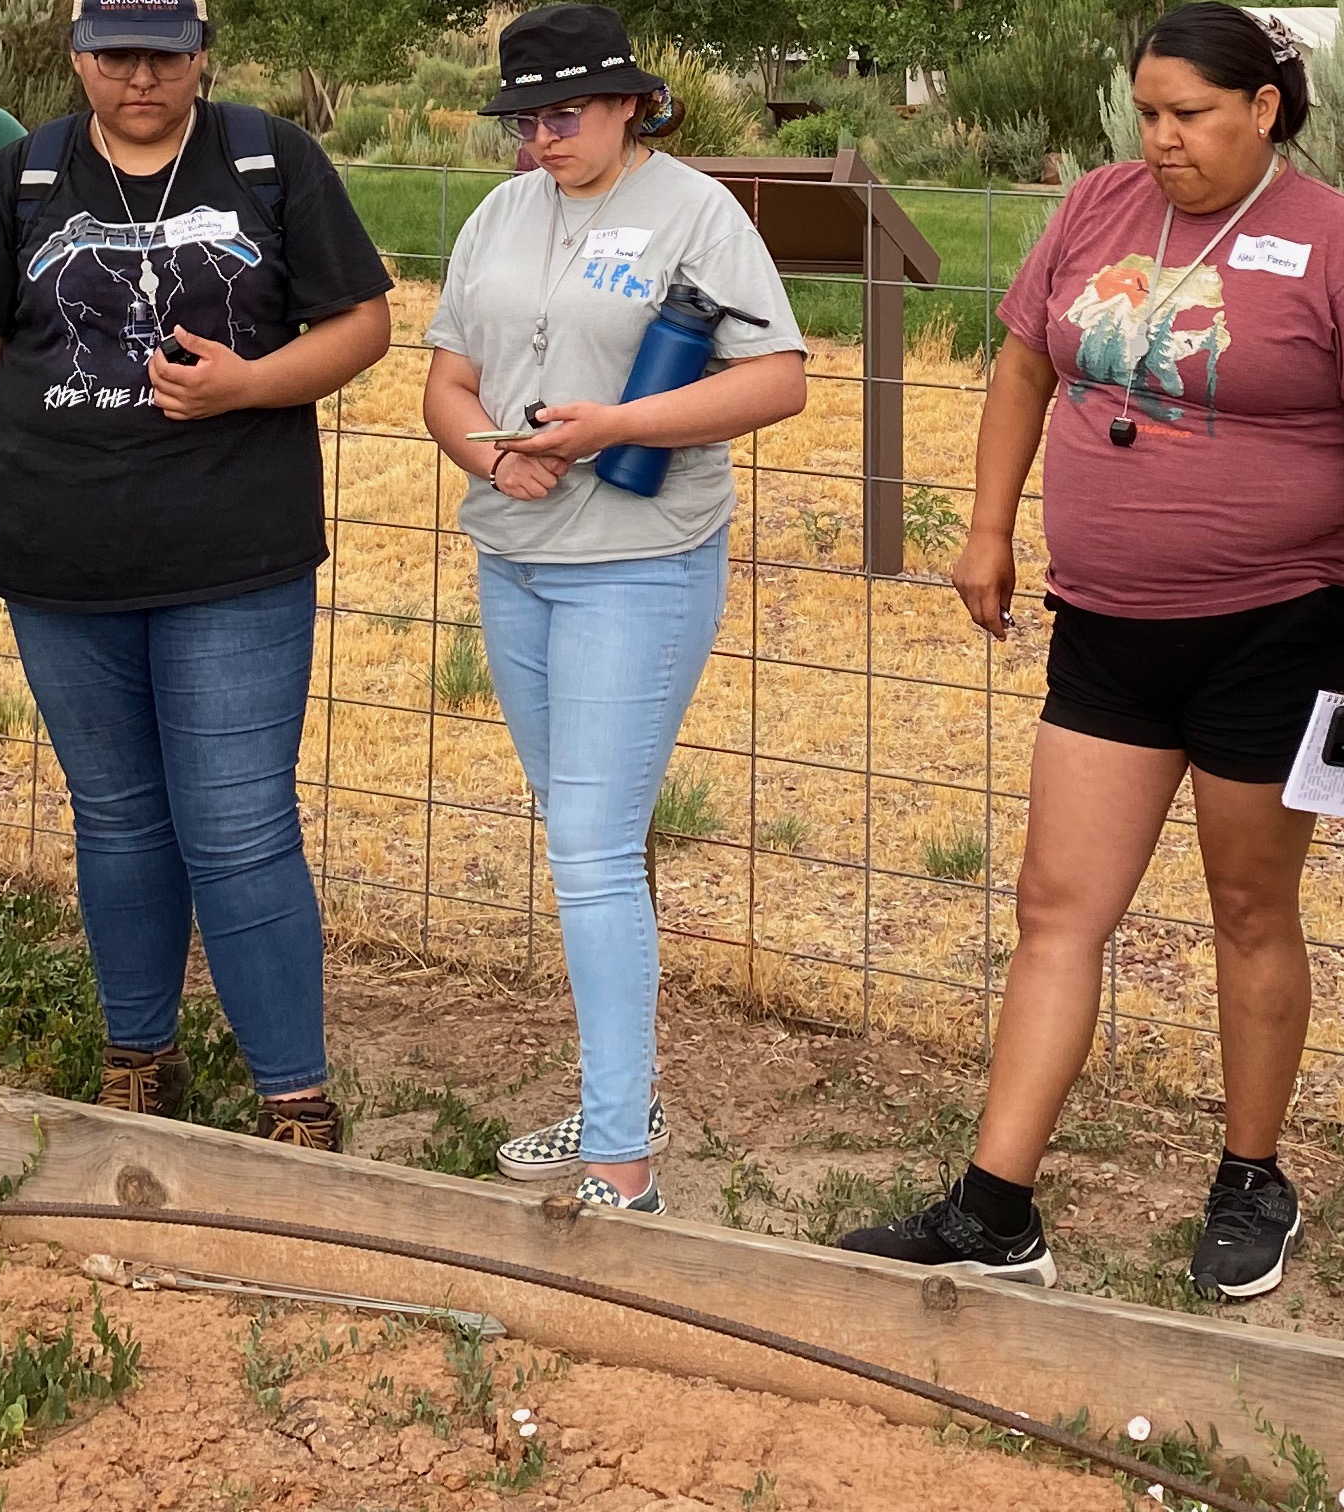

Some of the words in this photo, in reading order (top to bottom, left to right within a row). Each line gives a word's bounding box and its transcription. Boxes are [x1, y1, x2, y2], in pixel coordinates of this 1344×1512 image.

[601, 56, 625, 68] adidas
[556, 66, 587, 77] adidas
[516, 74, 543, 84] adidas
[43, 384, 88, 410] RIDE
[94, 387, 131, 409] THE
